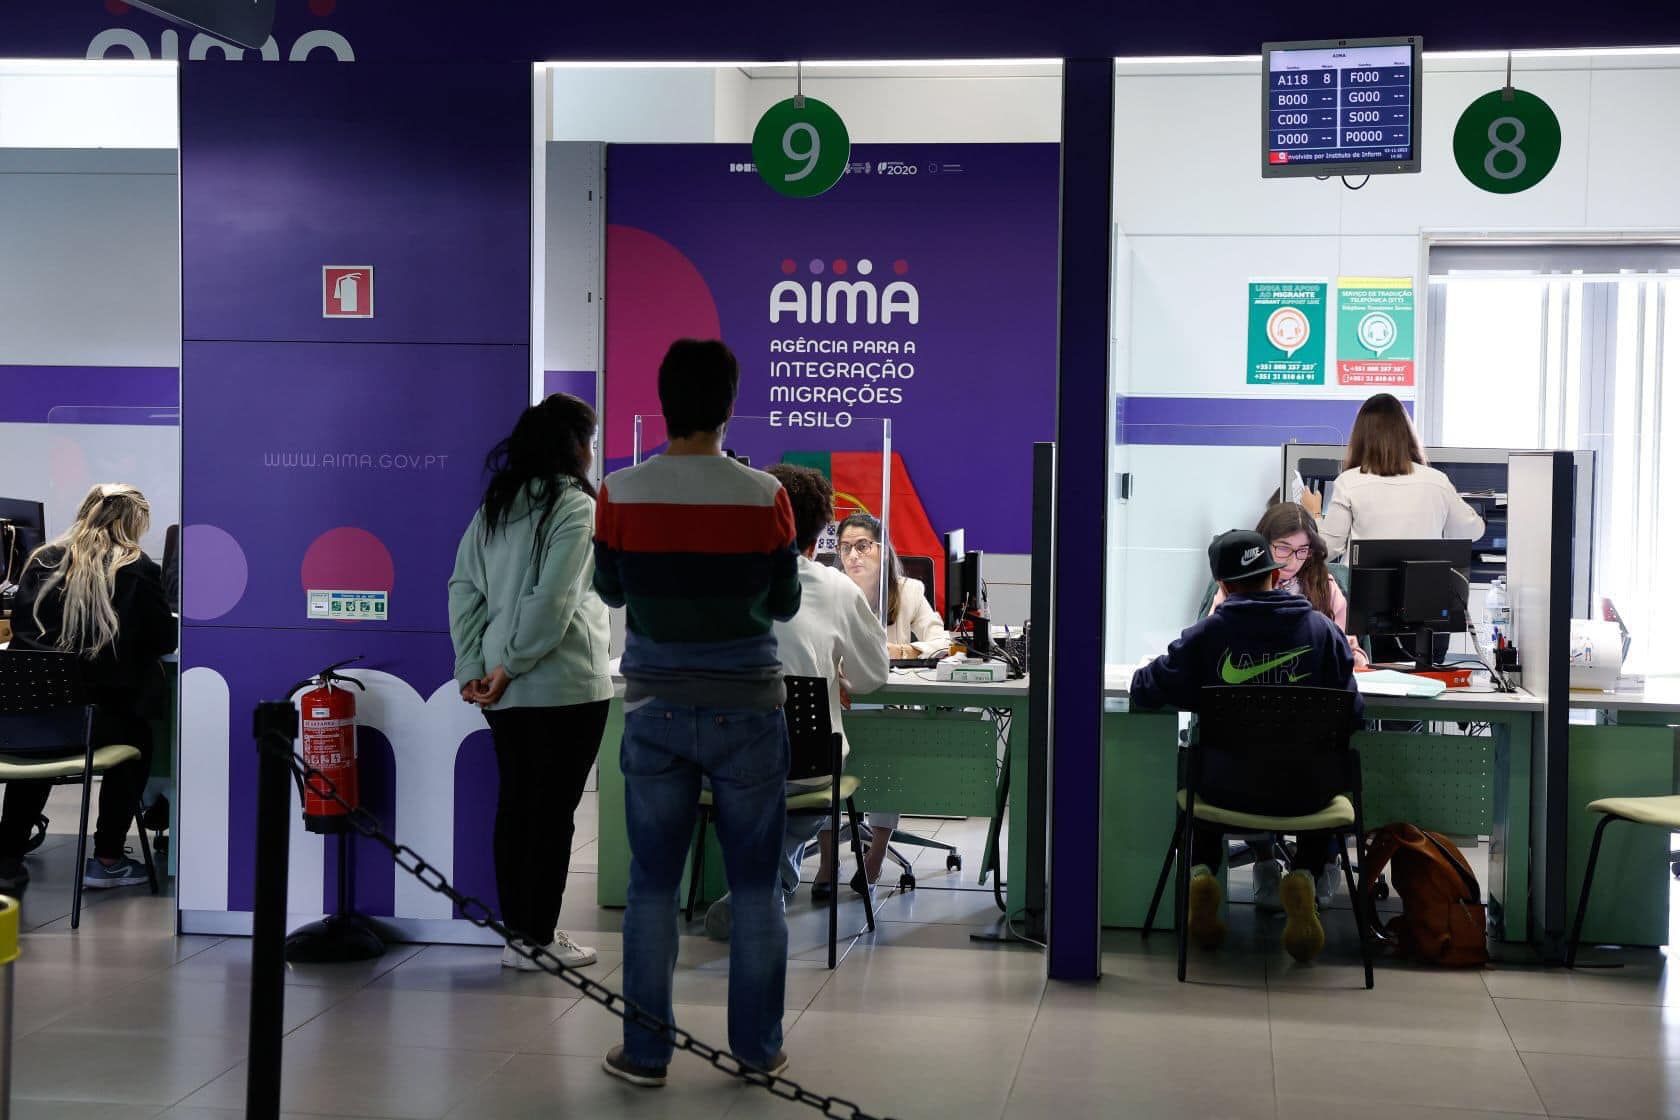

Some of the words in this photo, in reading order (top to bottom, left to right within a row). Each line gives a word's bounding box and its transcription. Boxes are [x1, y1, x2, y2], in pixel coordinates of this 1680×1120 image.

[1278, 74, 1308, 86] A118
[1323, 73, 1331, 84] 8
[1350, 71, 1379, 83] F000
[1278, 94, 1308, 106] B000
[1348, 91, 1380, 103] G000
[1277, 114, 1308, 125] C000
[1349, 111, 1380, 122] S000
[1277, 134, 1308, 145] D000
[1346, 131, 1382, 142] P0000
[782, 122, 821, 182] 9
[1484, 116, 1527, 180] 8
[887, 164, 918, 175] 2020
[769, 280, 920, 325] AIMA
[770, 337, 848, 354] AGÊNCIA
[853, 340, 899, 354] PARA
[904, 341, 916, 354] A
[770, 359, 915, 383] INTEGRAÇÃO
[770, 384, 903, 406] MIGRAÇÕES
[770, 410, 783, 427] E
[788, 411, 853, 428] ASILO
[263, 452, 449, 469] WWW.AIMA.GOV.PT
